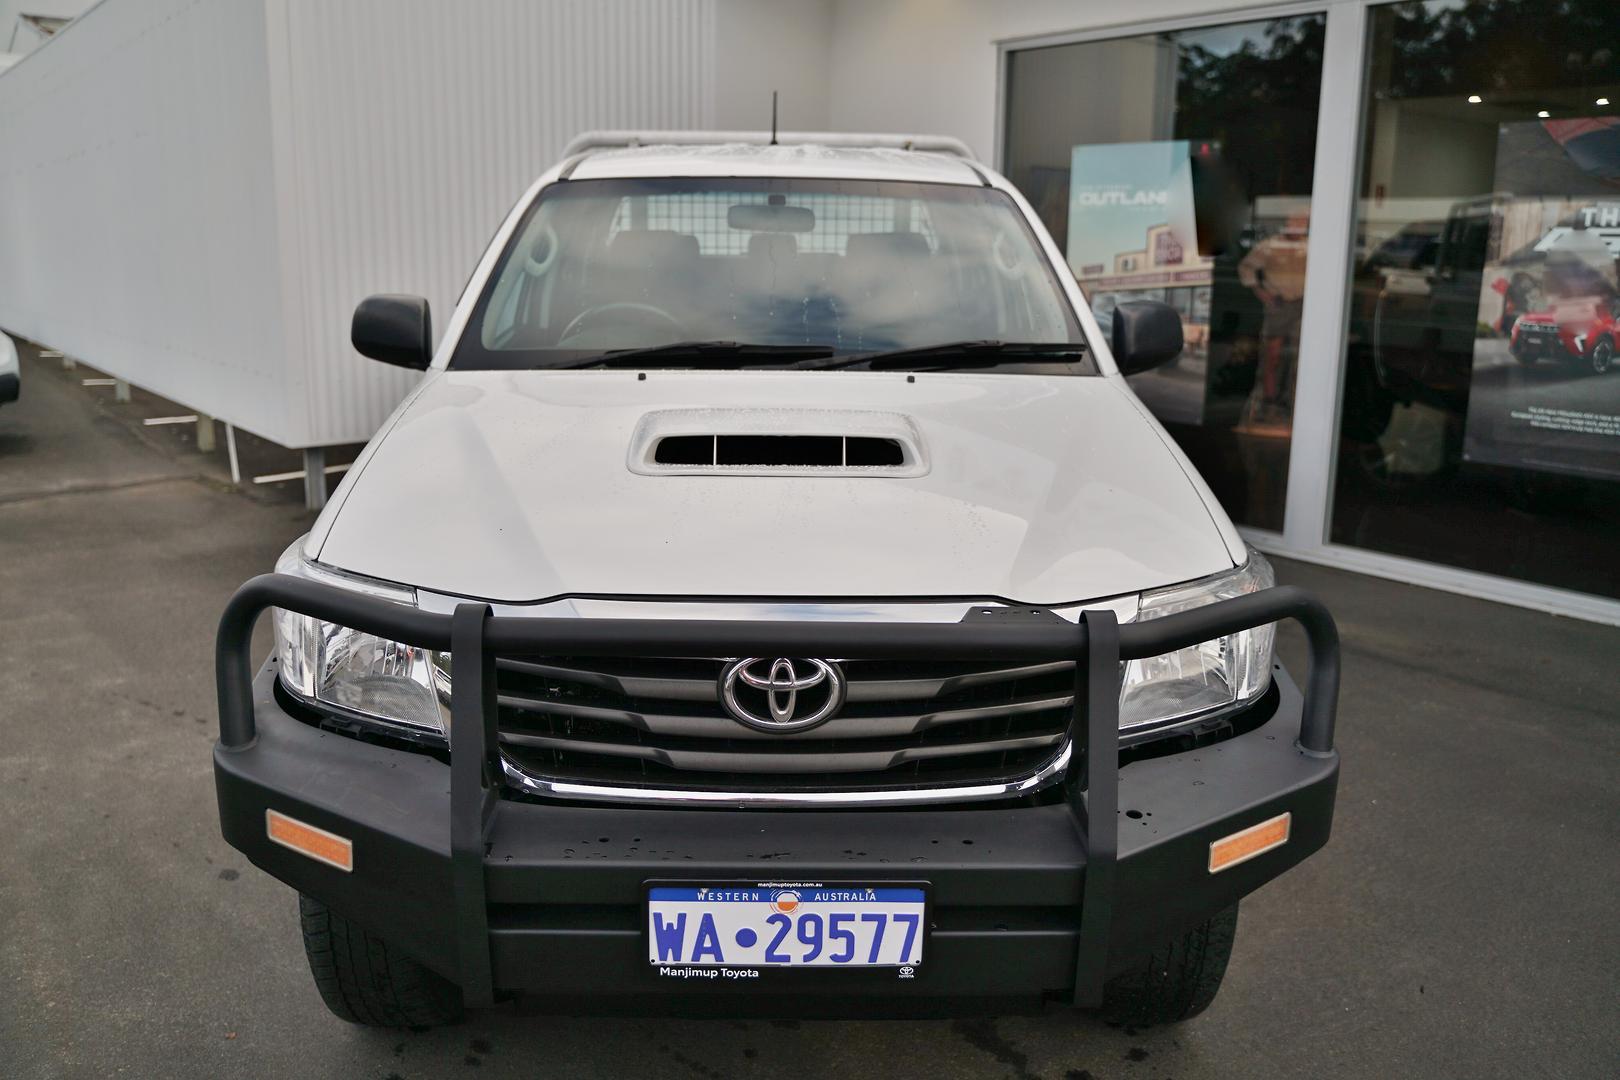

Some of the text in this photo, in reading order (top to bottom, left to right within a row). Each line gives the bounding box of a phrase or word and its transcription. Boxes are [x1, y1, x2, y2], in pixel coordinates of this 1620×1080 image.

[697, 892, 877, 901] WESTERN AUSTRALIA
[660, 967, 759, 979] Manjimup Toyota
